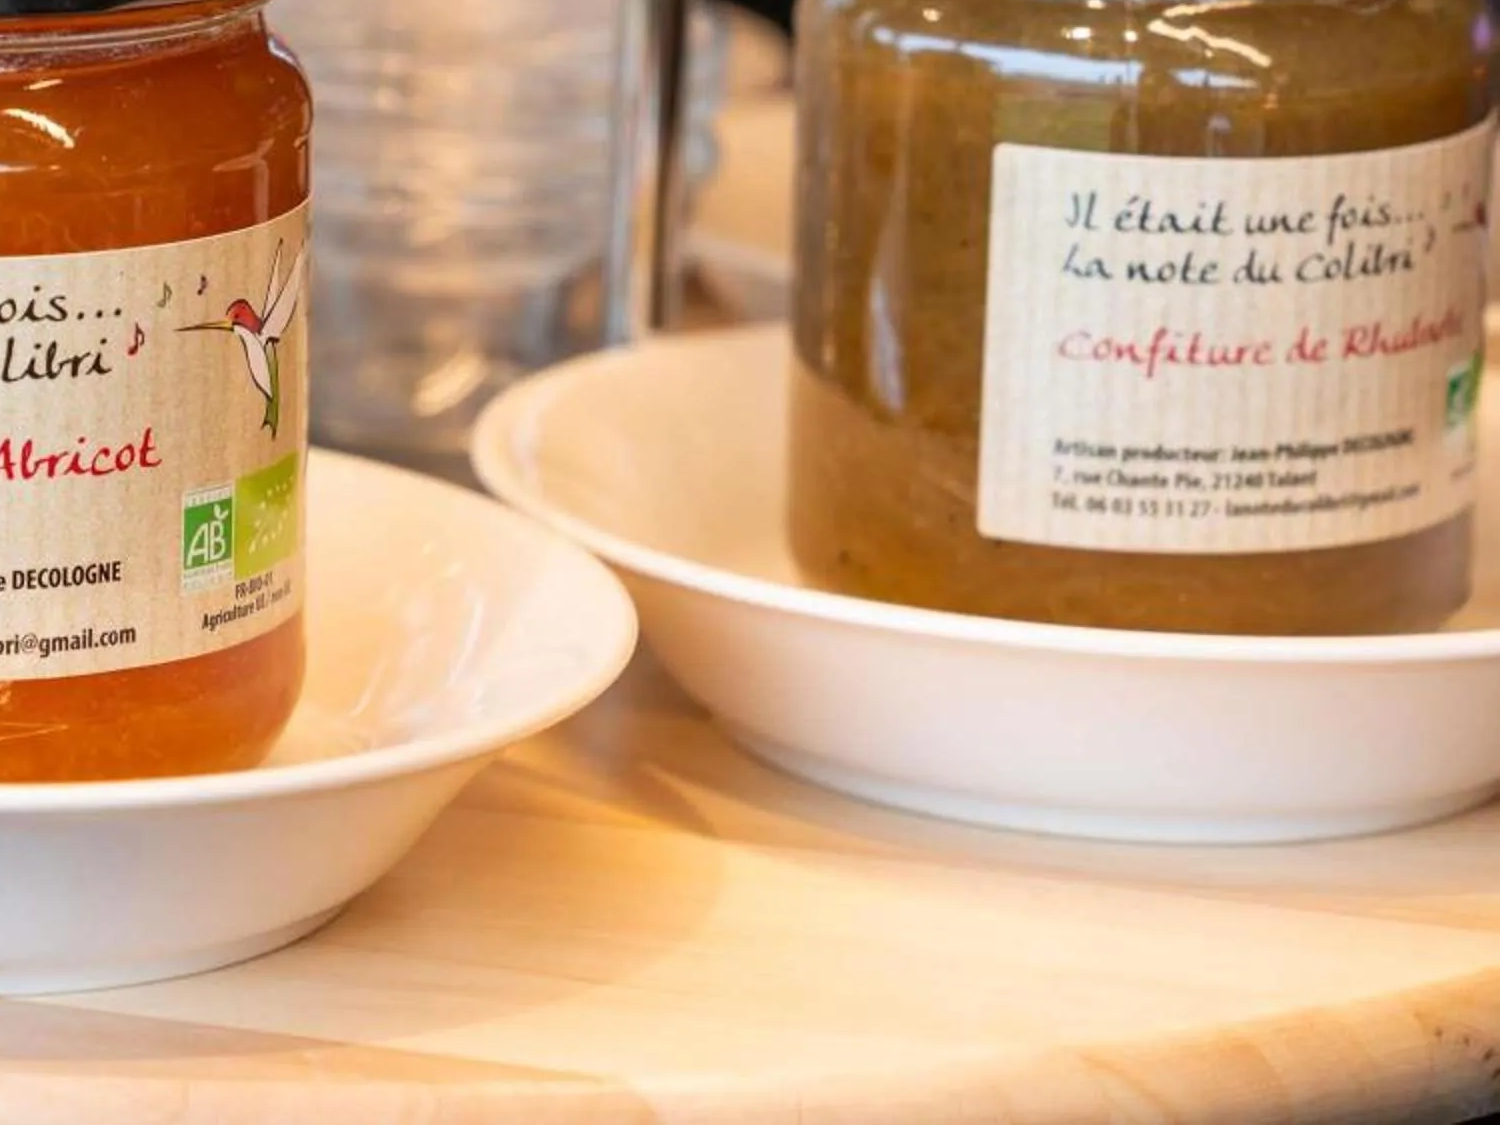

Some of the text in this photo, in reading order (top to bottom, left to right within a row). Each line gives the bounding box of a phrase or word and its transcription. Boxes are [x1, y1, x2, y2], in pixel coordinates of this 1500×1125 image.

[1115, 195, 1234, 236] était
[1245, 212, 1315, 235] une
[1327, 193, 1425, 246] fois...
[1063, 237, 1413, 285] La note du Colibri
[1058, 327, 1274, 378] Confiture
[1285, 326, 1328, 364] de
[186, 519, 227, 568] AB
[11, 561, 121, 590] DECOLOGNE
[202, 603, 254, 632] Agriculture
